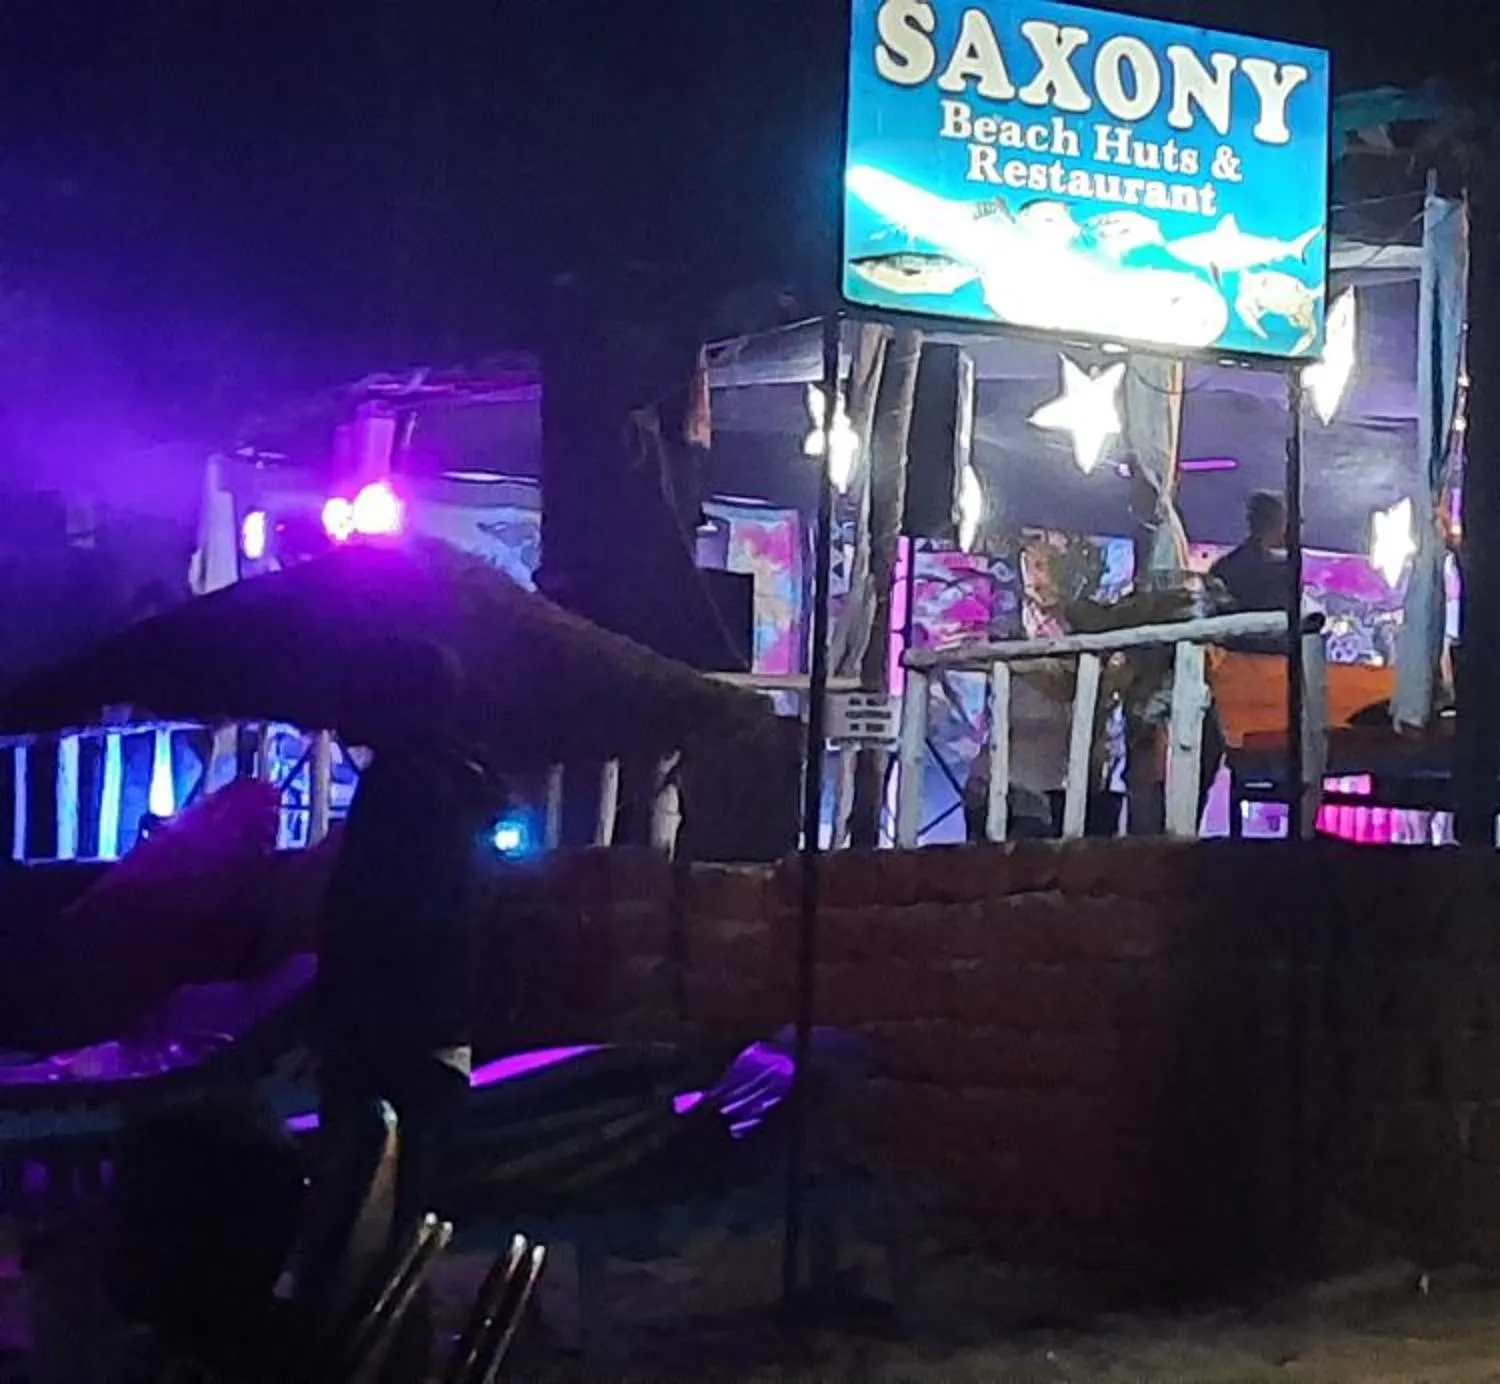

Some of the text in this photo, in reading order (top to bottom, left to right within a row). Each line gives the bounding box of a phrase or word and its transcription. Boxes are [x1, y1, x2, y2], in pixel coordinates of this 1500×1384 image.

[874, 0, 1308, 144] SAXONY
[940, 100, 1243, 183] Beach Huts &
[966, 144, 1217, 216] Restaurant
